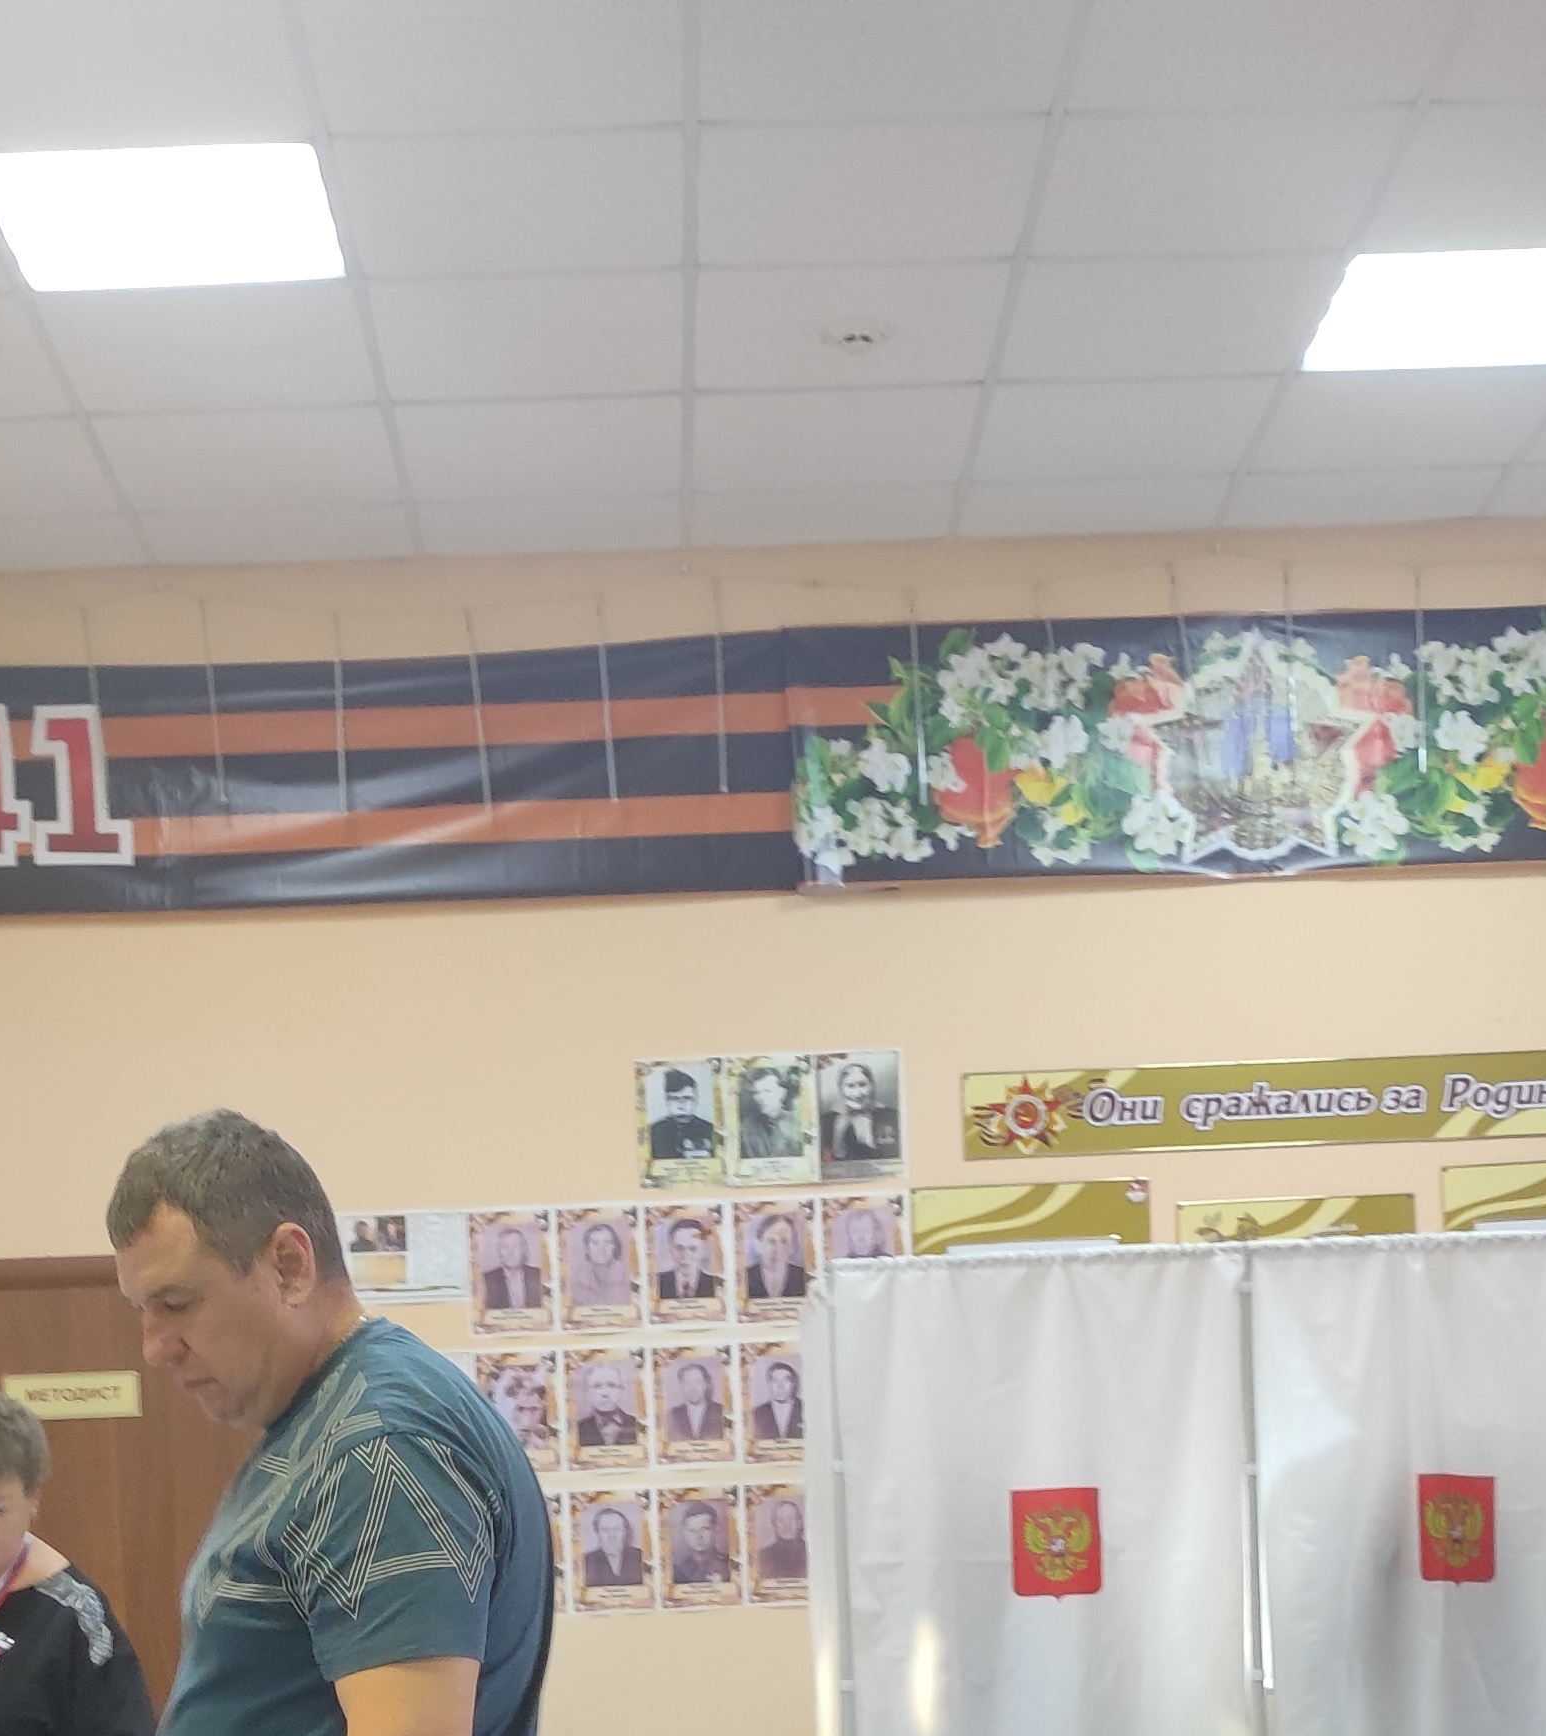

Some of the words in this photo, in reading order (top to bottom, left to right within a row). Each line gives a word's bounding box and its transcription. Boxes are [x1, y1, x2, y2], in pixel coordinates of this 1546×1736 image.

[1084, 1088, 1163, 1127] Они
[1180, 1082, 1377, 1131] сражались
[1380, 1085, 1427, 1114] за
